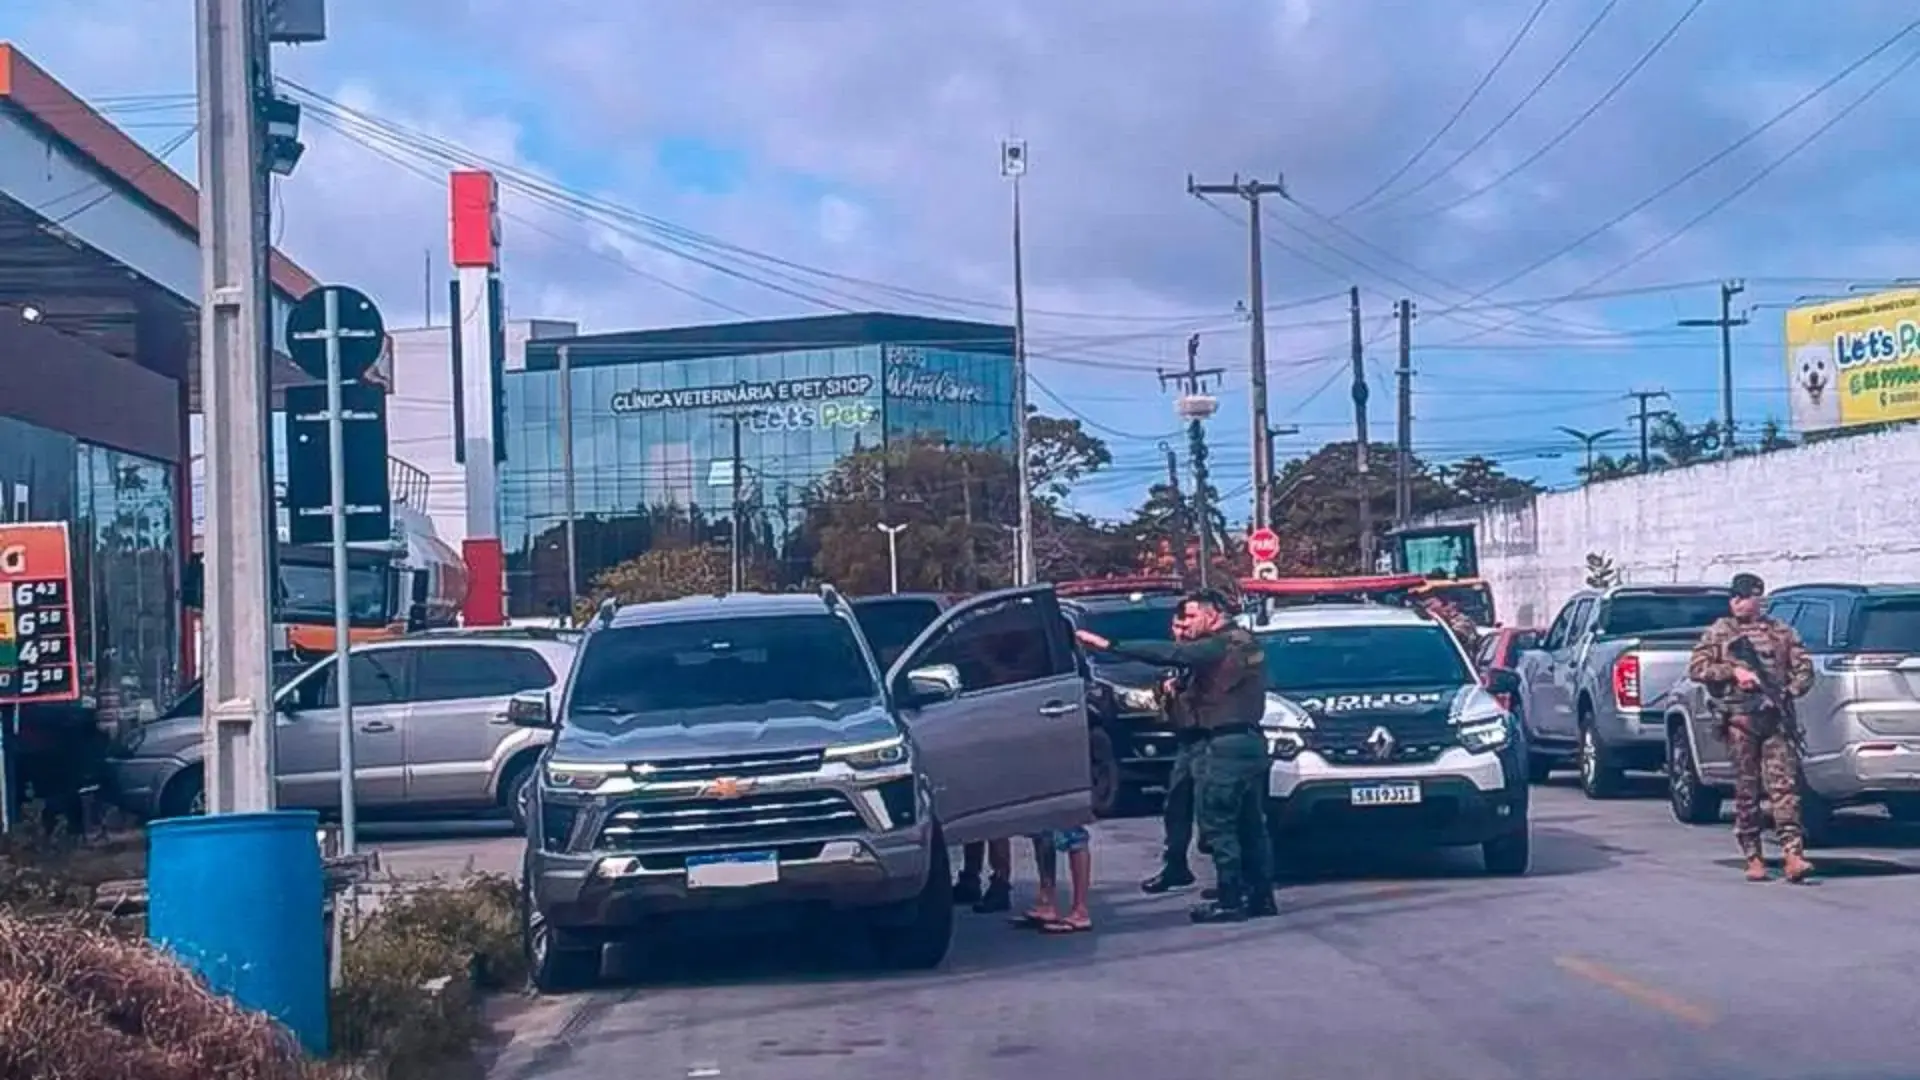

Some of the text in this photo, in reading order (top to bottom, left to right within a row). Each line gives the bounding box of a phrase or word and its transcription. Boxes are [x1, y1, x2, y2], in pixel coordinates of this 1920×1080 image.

[1836, 327, 1894, 365] Let's
[613, 391, 673, 411] CLÍNICA
[673, 382, 774, 406] VETERINÁRIA
[778, 383, 789, 399] E
[792, 381, 822, 398] PET
[825, 377, 871, 396] SHOP
